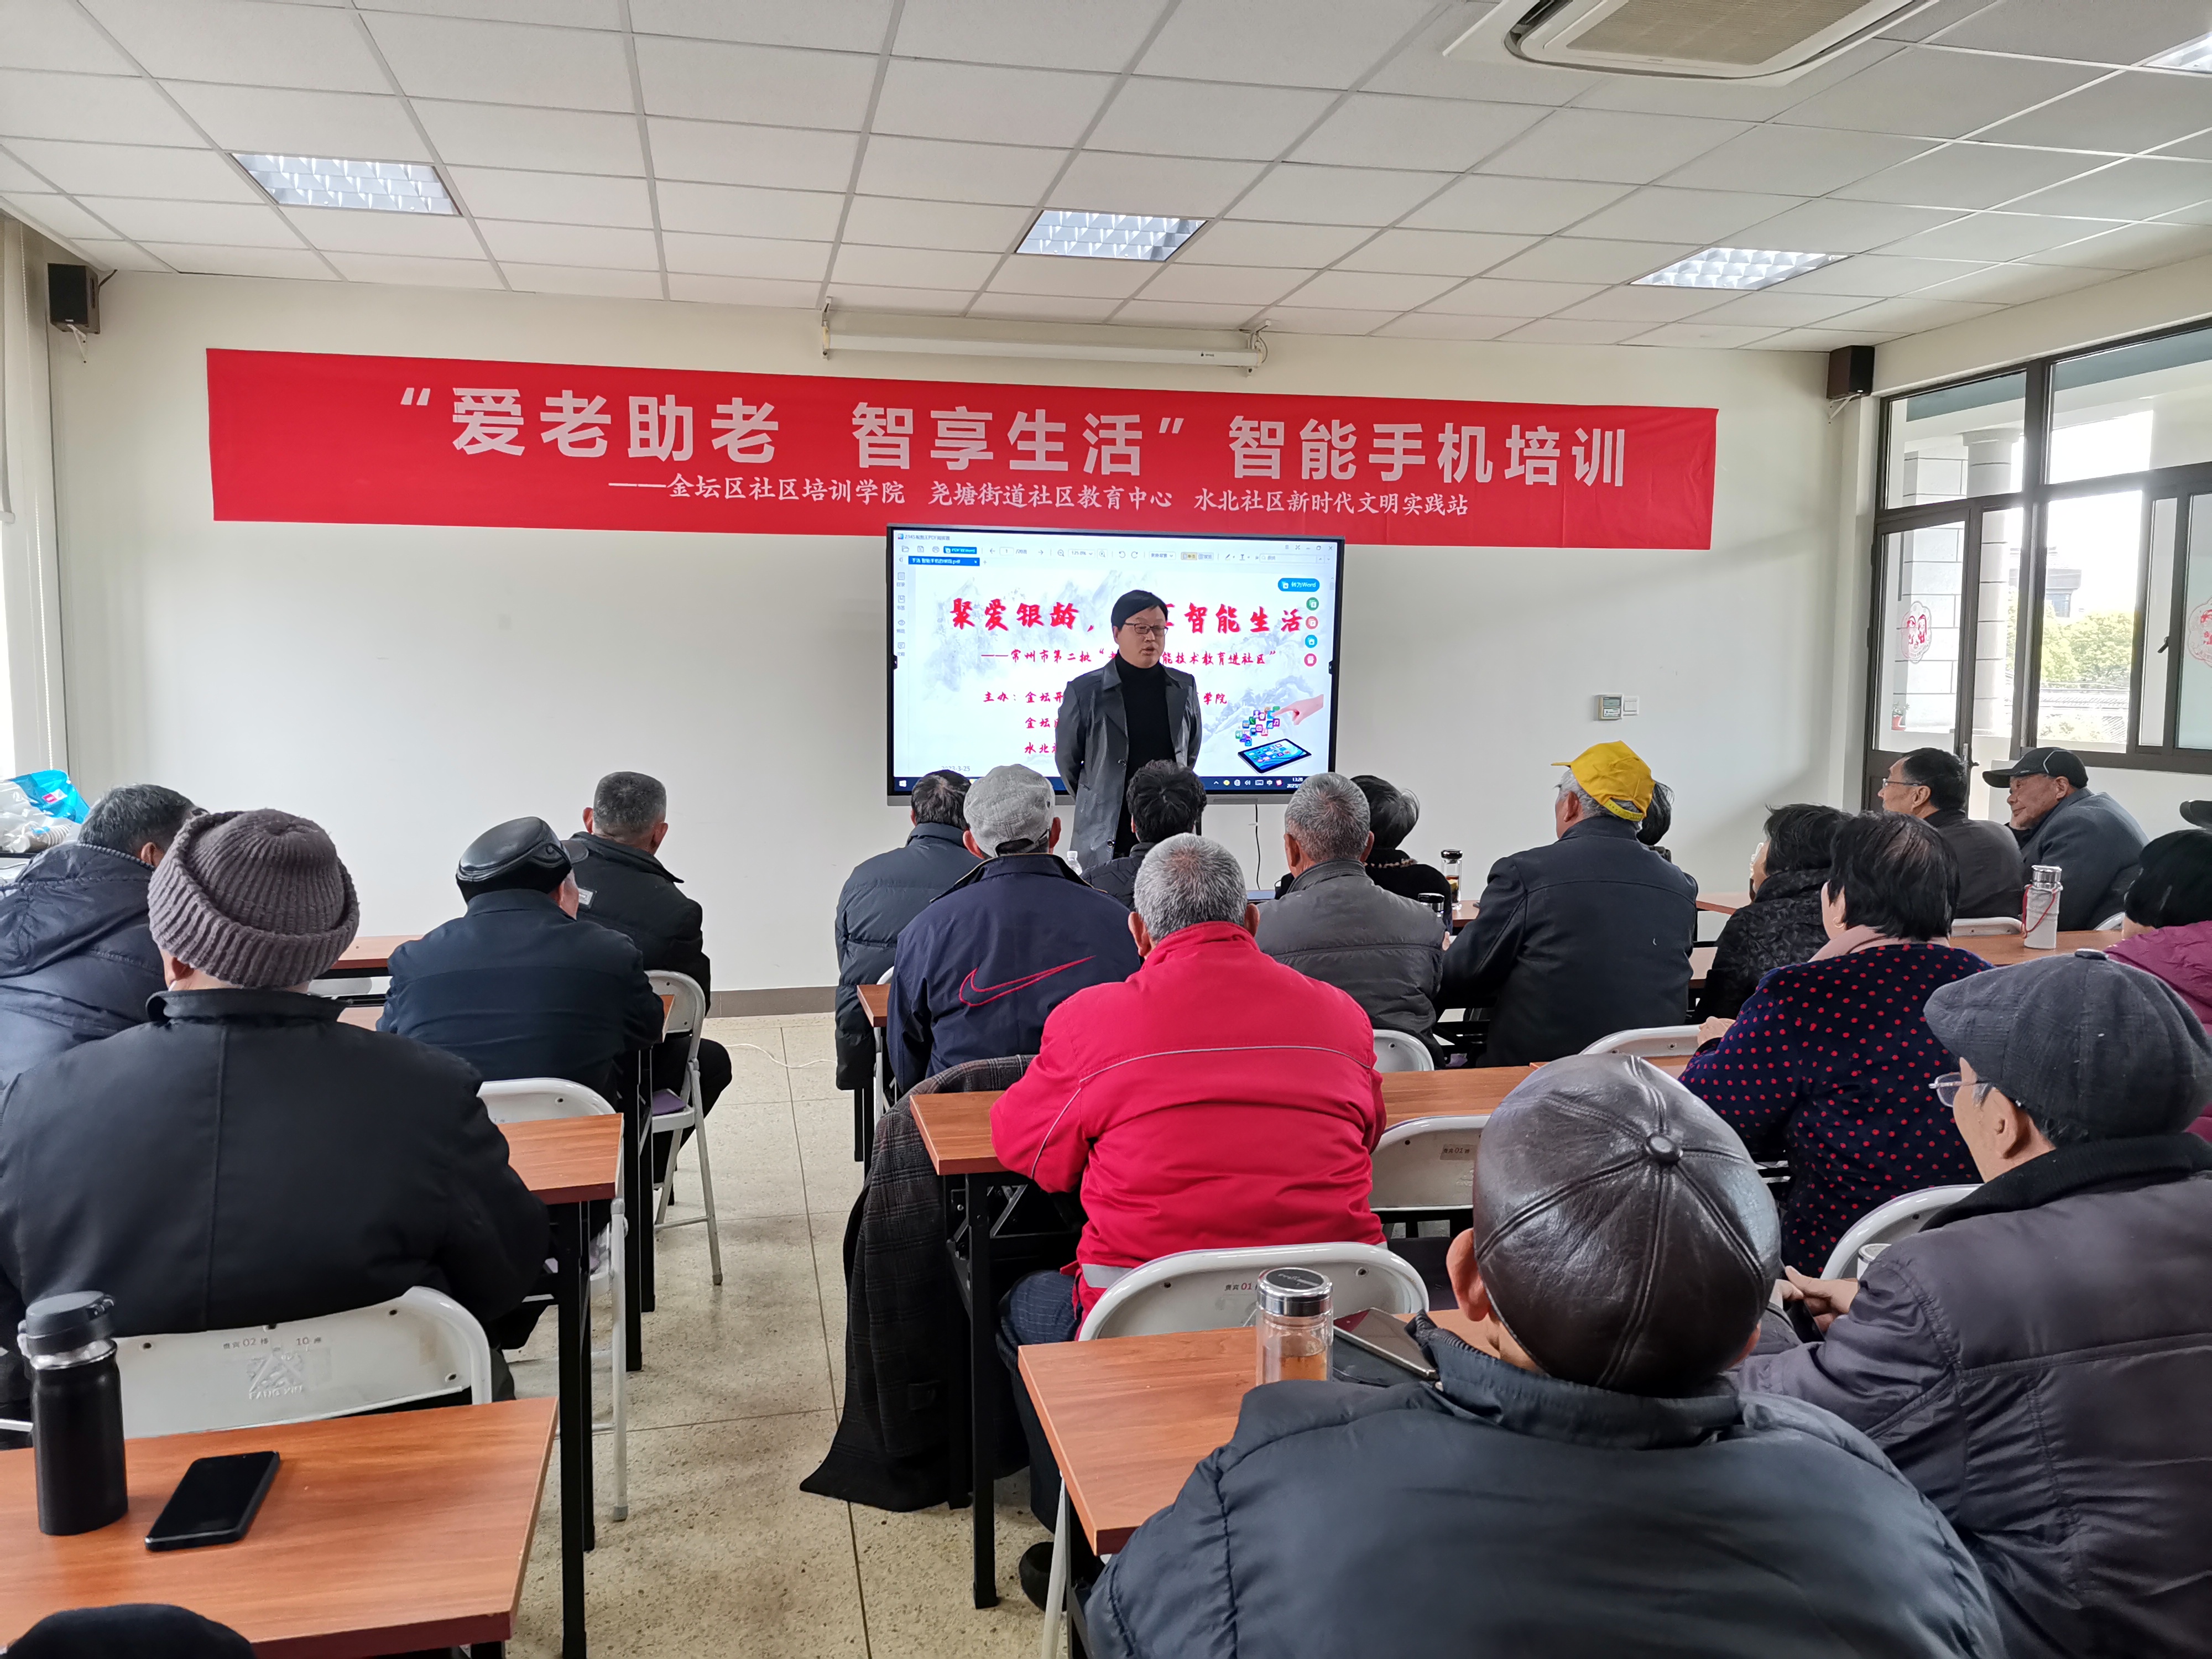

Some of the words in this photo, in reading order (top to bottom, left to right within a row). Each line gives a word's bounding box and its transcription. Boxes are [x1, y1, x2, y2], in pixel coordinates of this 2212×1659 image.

[400, 387, 779, 463] “爱老助老
[608, 474, 905, 504] ——金坛区社区培训学院
[928, 481, 1172, 510] 尧塘街道社区教育中心
[1194, 488, 1468, 516] 水北社区新时代文明实践站
[1025, 717, 1058, 729] 金坛
